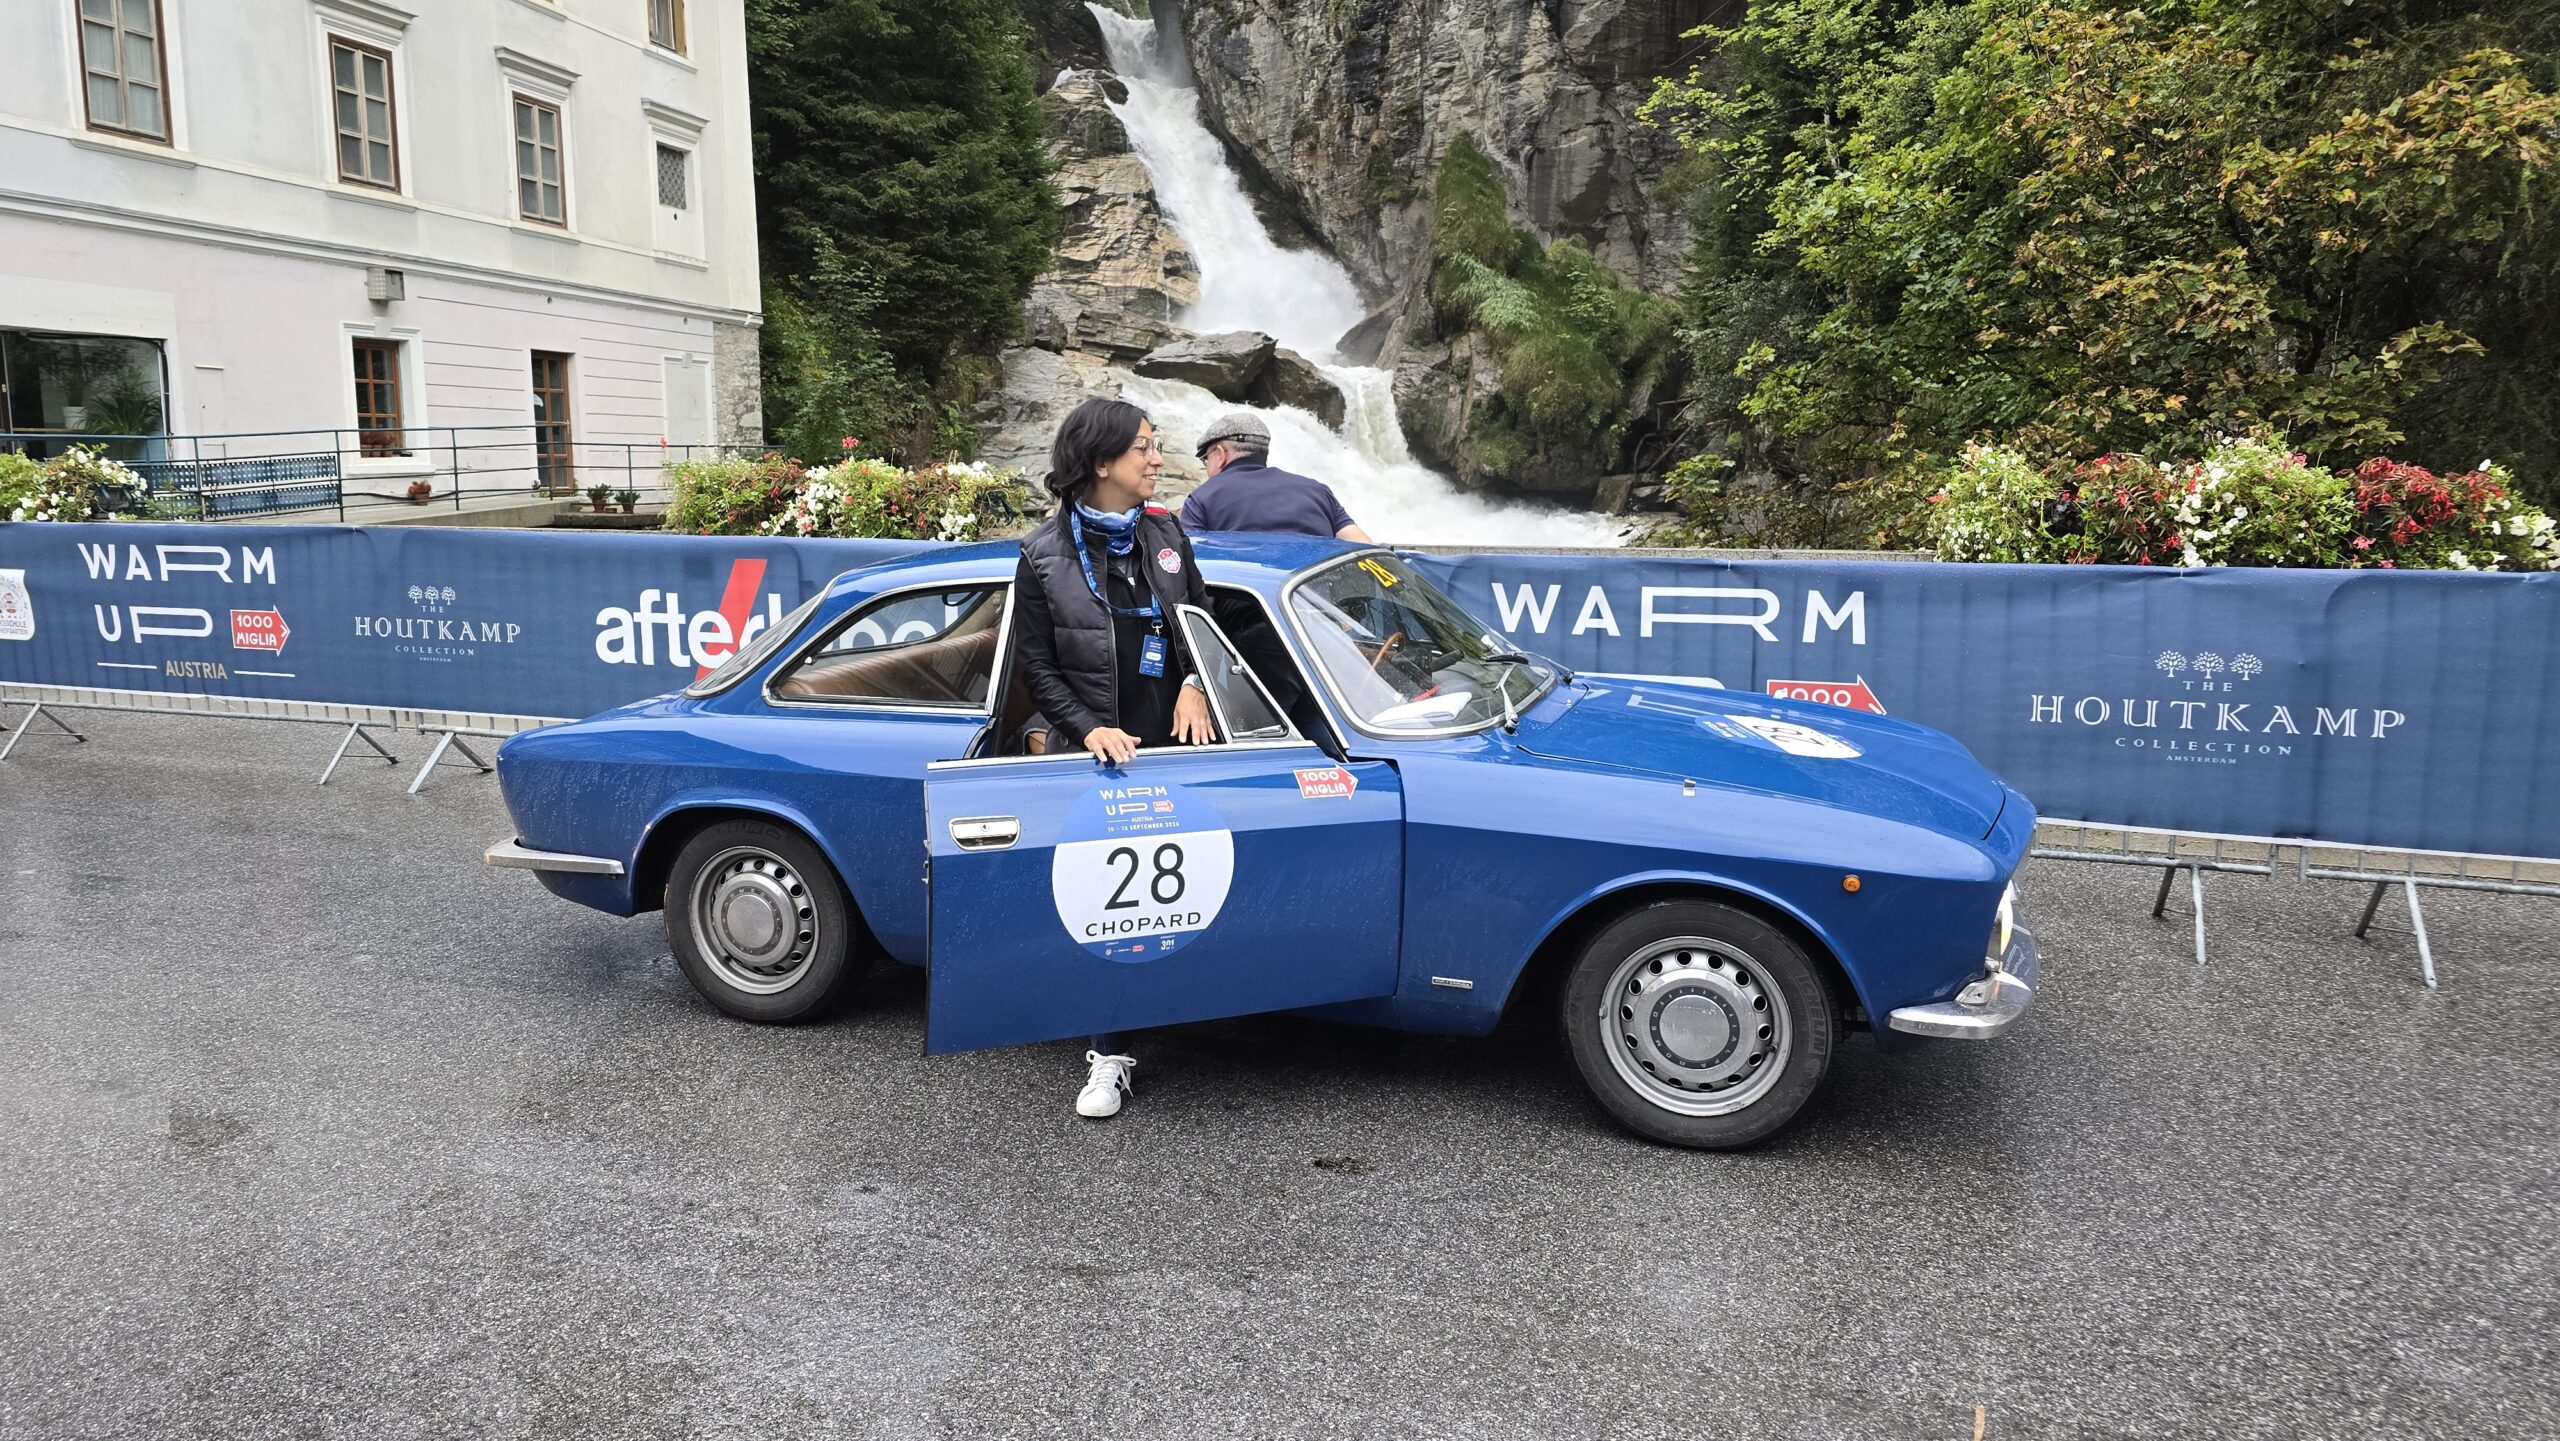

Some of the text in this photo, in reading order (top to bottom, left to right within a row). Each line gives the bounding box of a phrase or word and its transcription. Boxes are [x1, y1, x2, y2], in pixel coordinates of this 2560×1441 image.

[77, 543, 276, 585] WARM
[1357, 558, 1398, 588] 28
[420, 605, 445, 614] THE
[1491, 582, 1866, 645] WARM
[94, 604, 214, 644] UP
[236, 614, 273, 629] 1000
[354, 616, 521, 644] HOUTKAMP
[236, 632, 277, 646] MIGLIA
[395, 644, 475, 657] COLLECTION
[165, 659, 228, 680] AUSTRIA
[2182, 680, 2233, 692] THE
[2030, 694, 2406, 738] HOUTKAMP
[2115, 737, 2292, 756] COLLECTION
[2166, 754, 2238, 765] AMSTERDAM
[1302, 770, 1340, 782] 1000
[1099, 785, 1168, 800] WARM
[1304, 782, 1348, 796] MIGLIA
[1105, 802, 1149, 816] UP
[1129, 821, 1164, 831] SEPTEMBER
[1104, 842, 1186, 911] 28
[1085, 911, 1202, 937] CHOPARD
